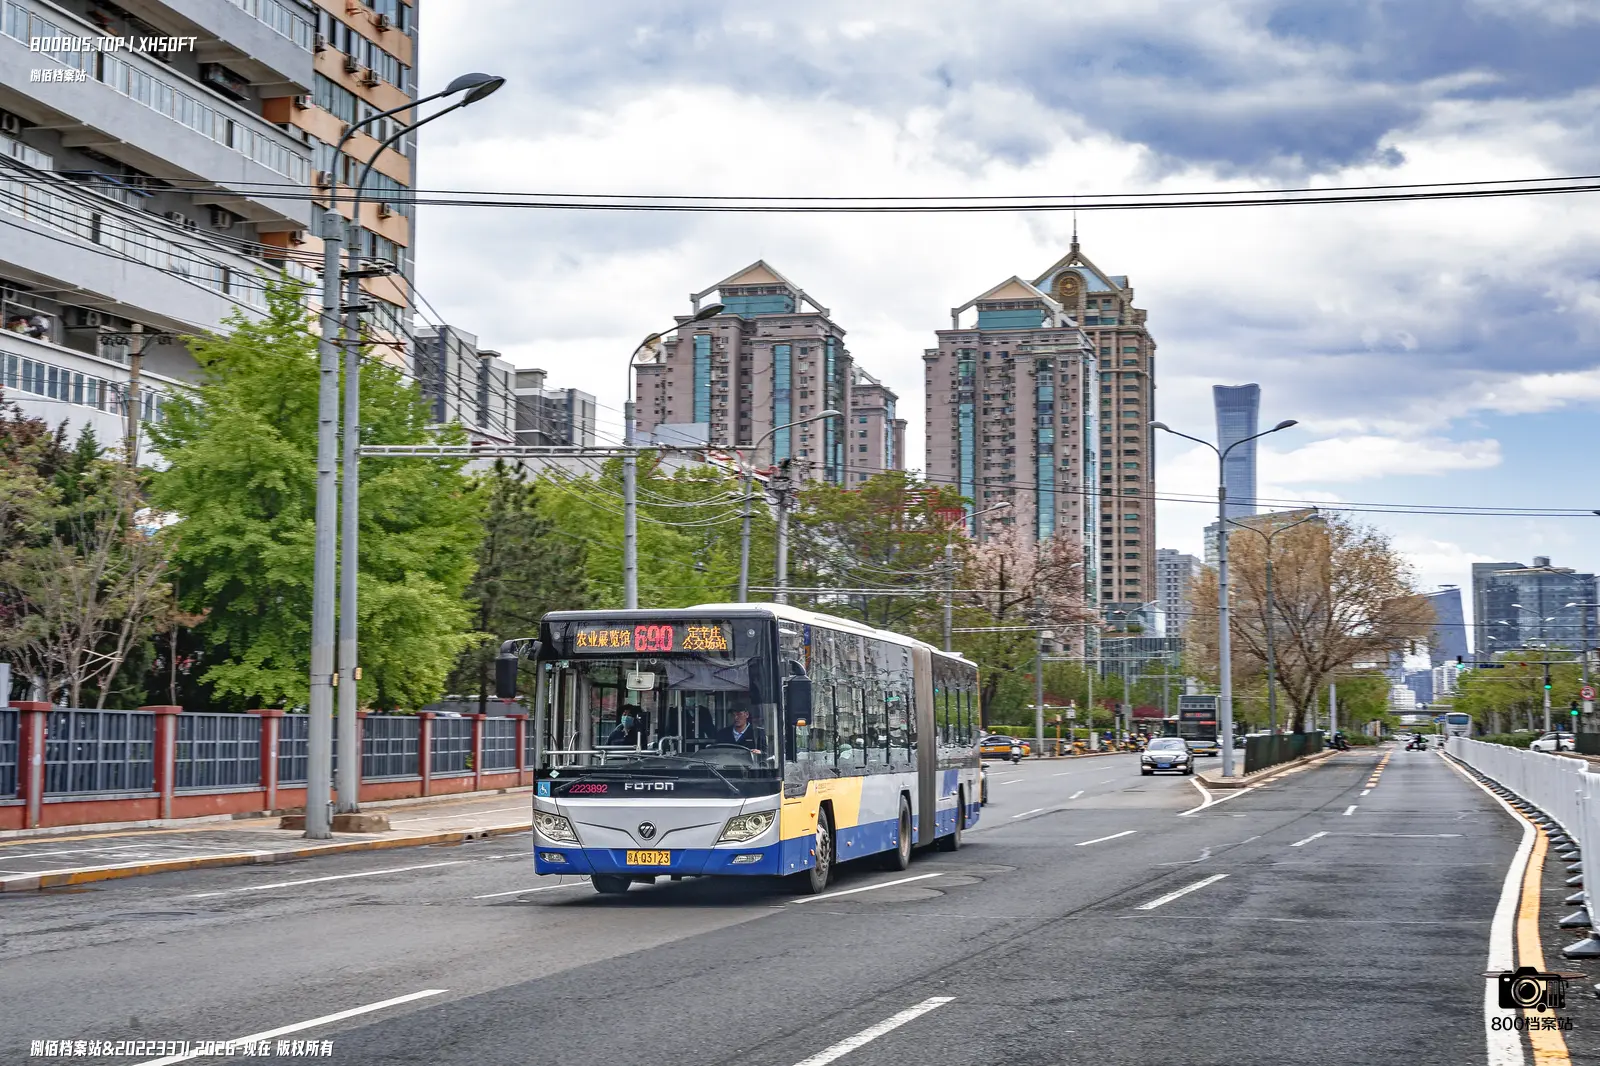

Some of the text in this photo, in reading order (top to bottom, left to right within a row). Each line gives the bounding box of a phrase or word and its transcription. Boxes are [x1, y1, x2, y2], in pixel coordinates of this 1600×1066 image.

[576, 625, 673, 652] 农业展览馆 690
[687, 626, 721, 639] 定辛庄
[682, 638, 727, 650] 公交场站
[569, 784, 608, 793] 2223892
[624, 782, 674, 790] FOTON
